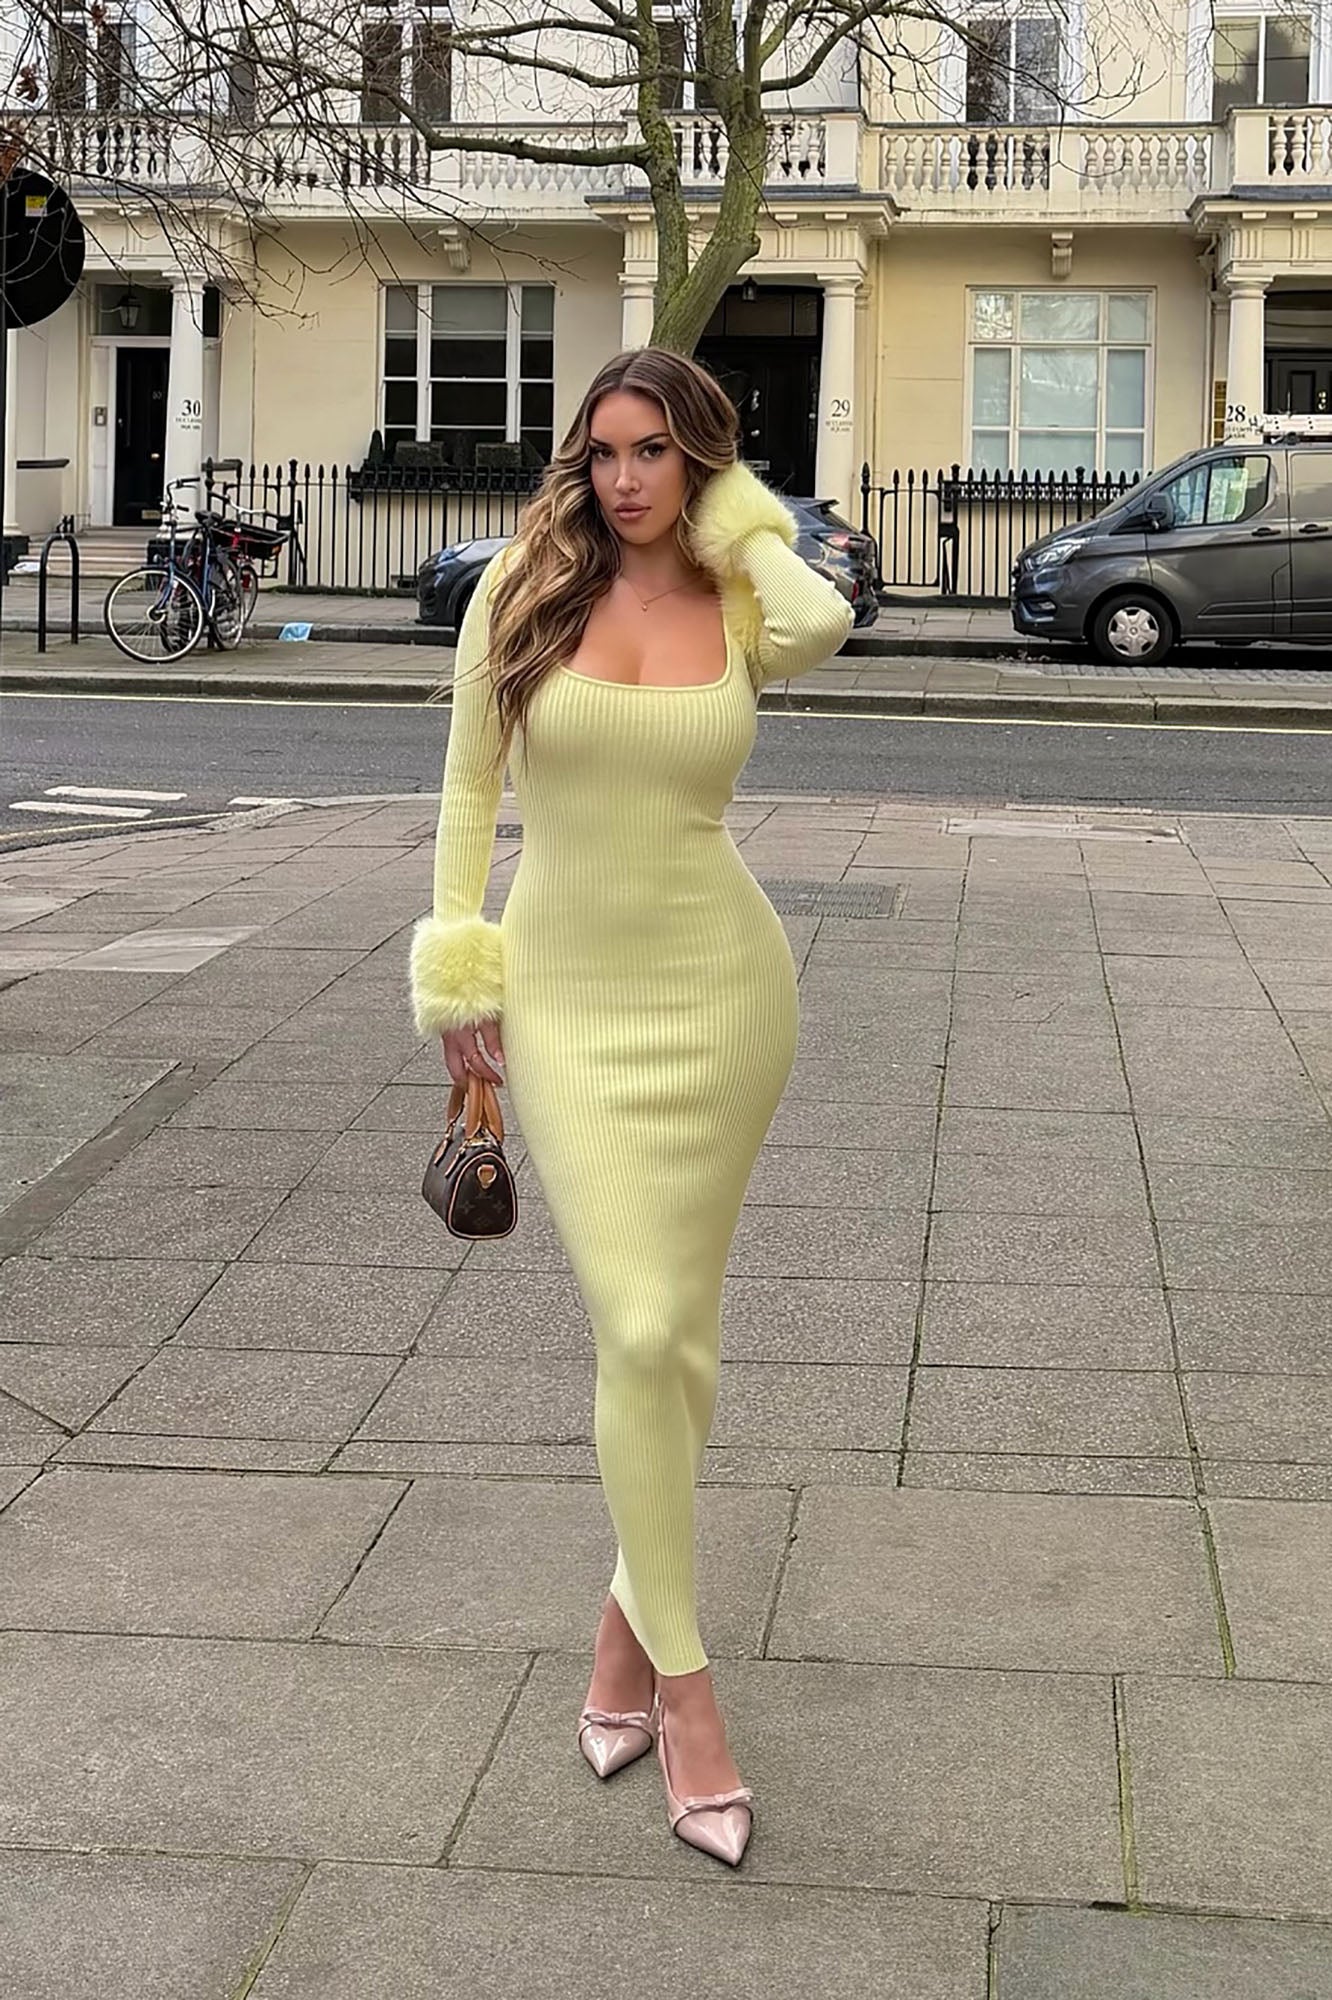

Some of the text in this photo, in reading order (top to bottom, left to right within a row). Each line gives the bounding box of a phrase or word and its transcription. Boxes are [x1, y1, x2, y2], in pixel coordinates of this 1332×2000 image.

[181, 399, 201, 417] 30
[831, 399, 851, 417] 29
[1226, 404, 1246, 423] 28
